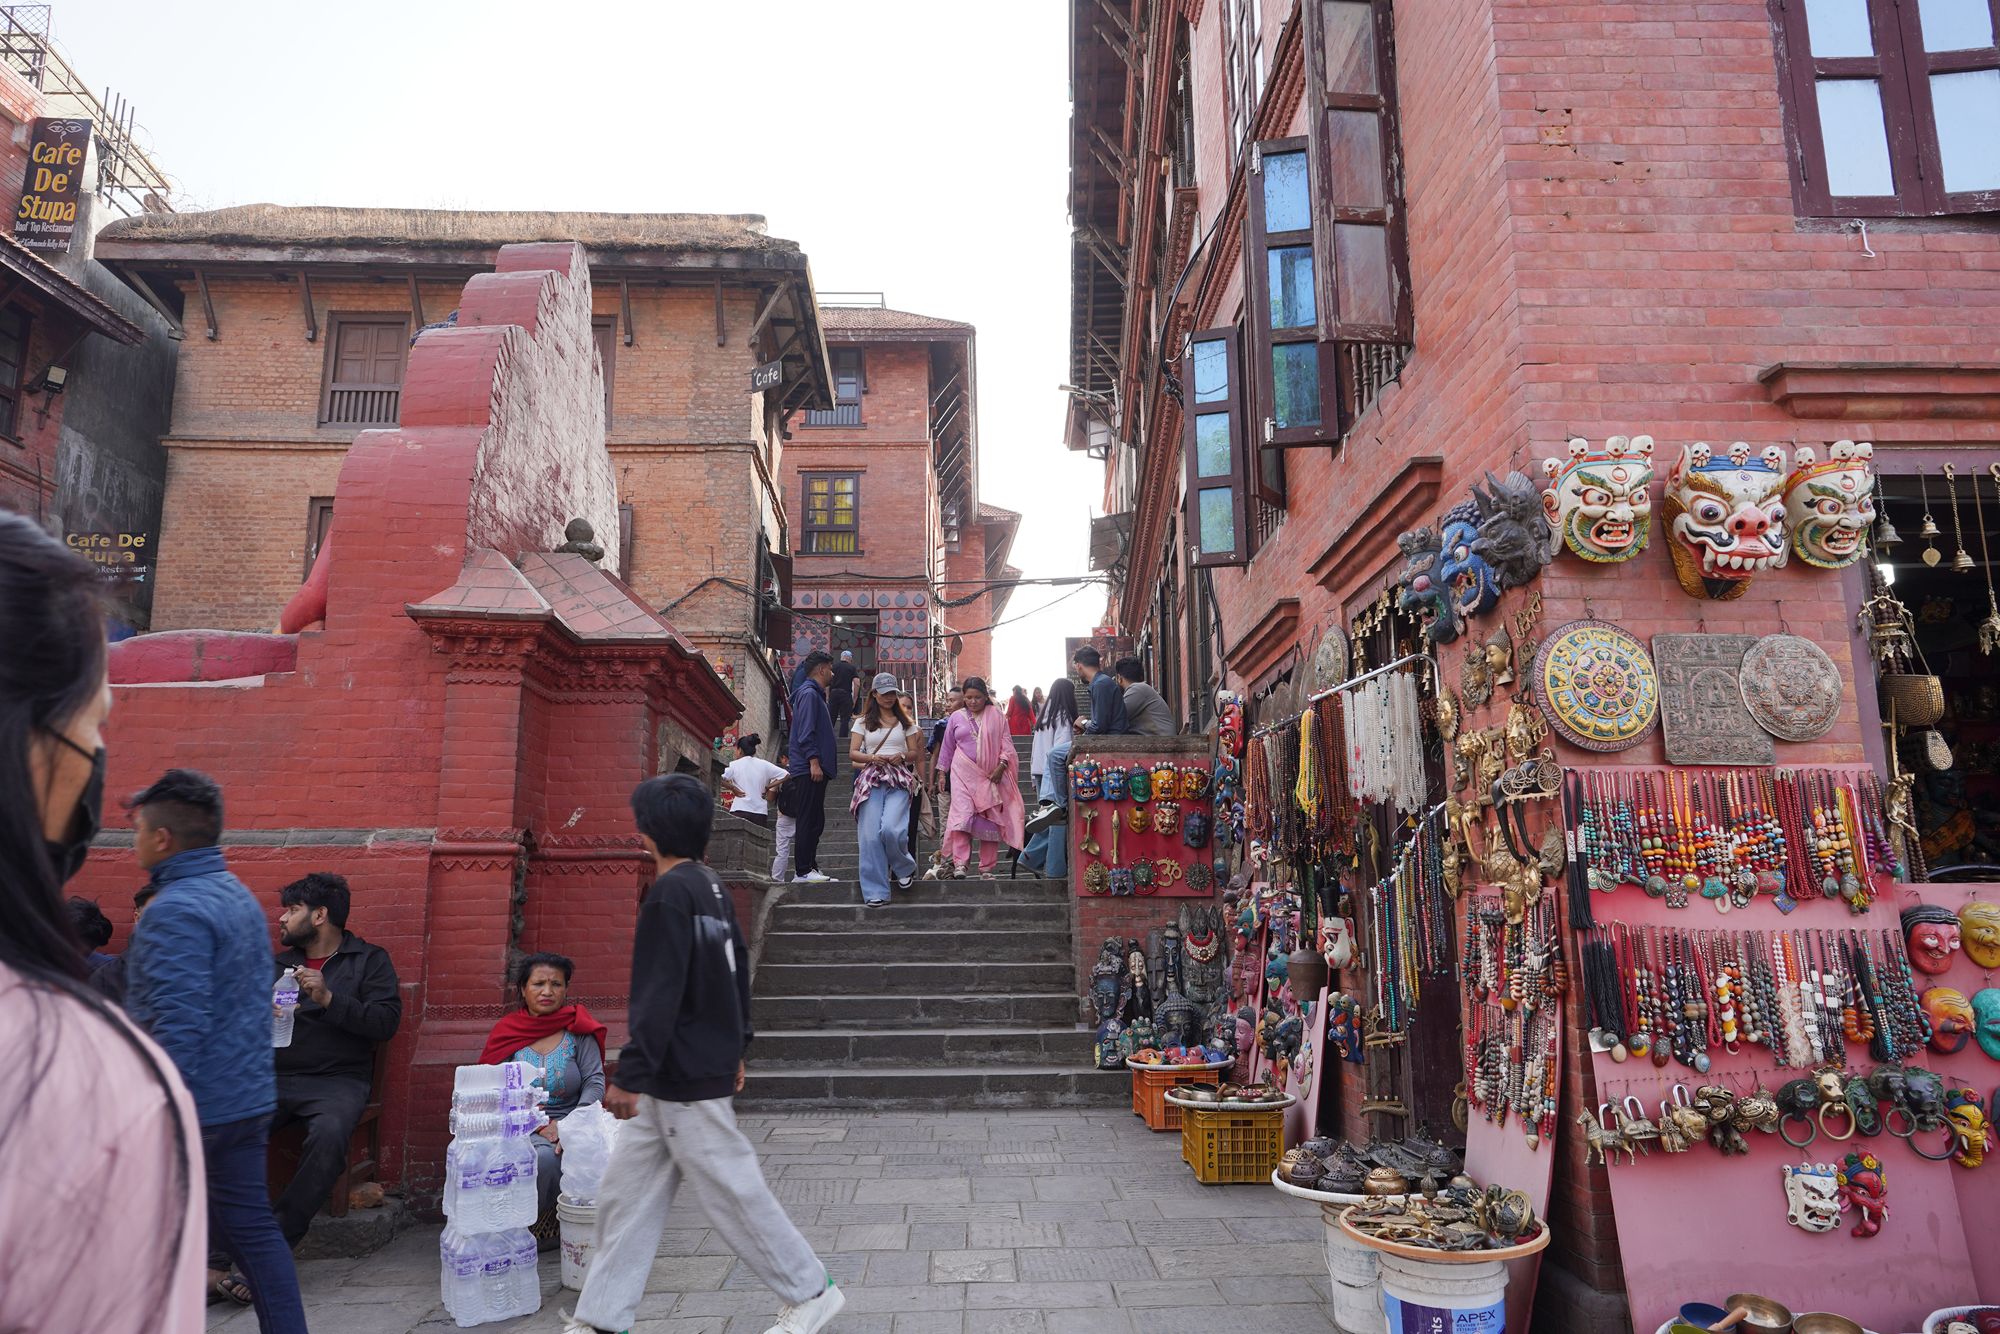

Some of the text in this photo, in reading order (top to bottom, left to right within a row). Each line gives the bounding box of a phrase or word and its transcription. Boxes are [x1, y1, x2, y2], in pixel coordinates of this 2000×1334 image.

[32, 142, 82, 166] Cafe
[18, 194, 77, 223] Stupa
[30, 222, 41, 233] Top
[66, 533, 111, 547] Cafe
[1456, 1309, 1496, 1323] APEX
